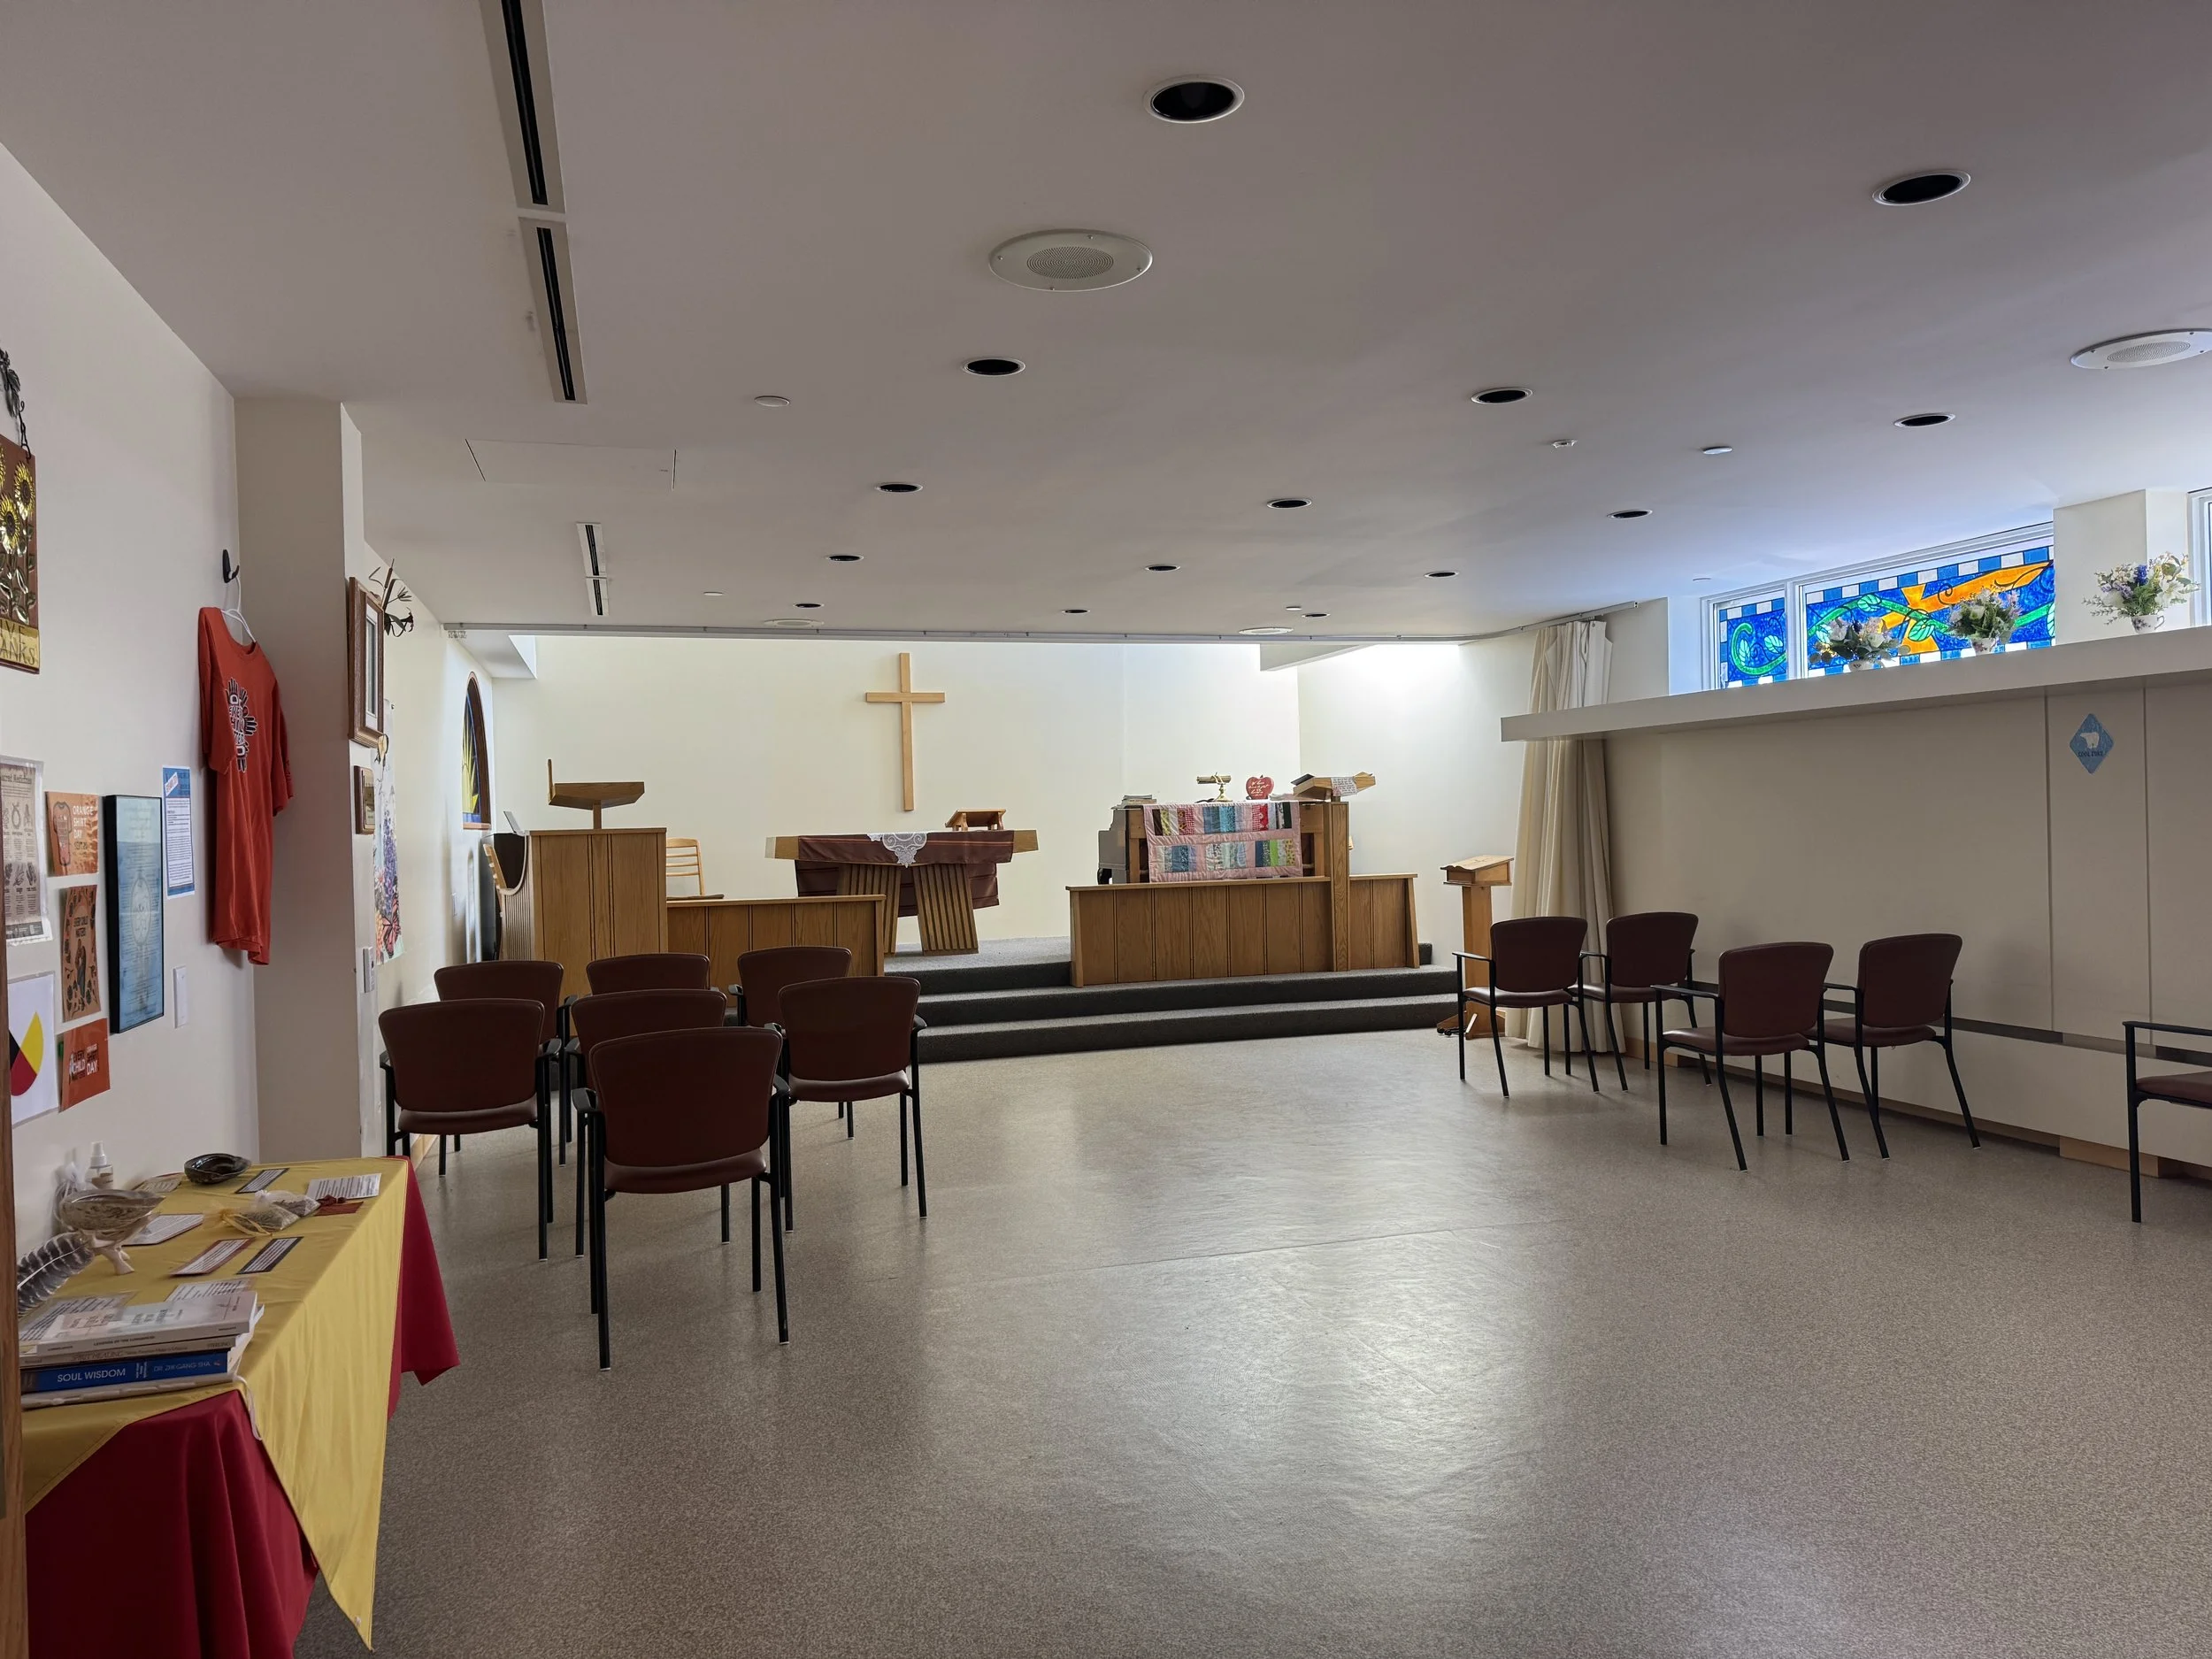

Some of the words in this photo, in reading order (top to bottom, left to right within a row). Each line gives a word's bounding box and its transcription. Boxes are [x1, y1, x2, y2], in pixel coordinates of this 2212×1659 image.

[0, 618, 26, 644] IVE
[0, 640, 35, 665] ANKS
[87, 1060, 97, 1076] DAY
[58, 1374, 82, 1383] SOUL
[84, 1368, 126, 1380] WISDOM
